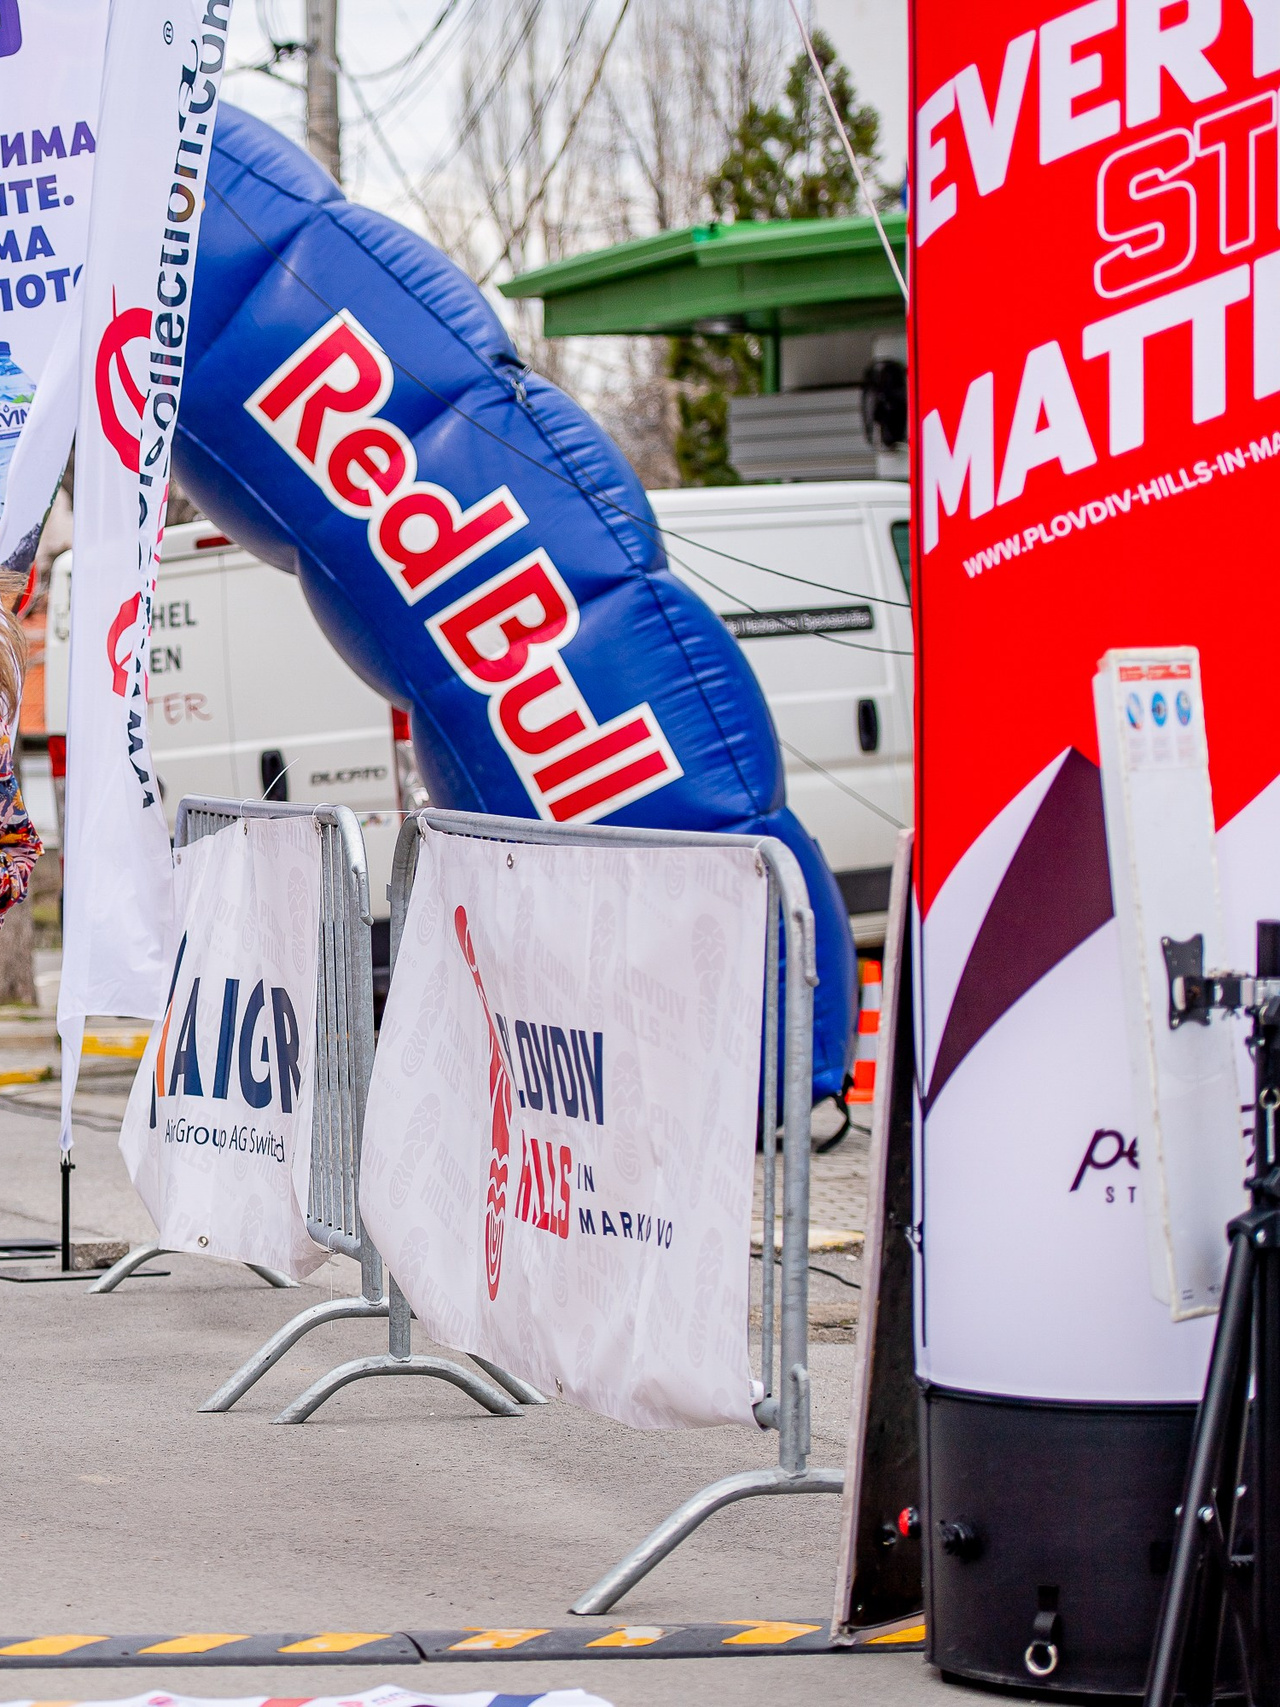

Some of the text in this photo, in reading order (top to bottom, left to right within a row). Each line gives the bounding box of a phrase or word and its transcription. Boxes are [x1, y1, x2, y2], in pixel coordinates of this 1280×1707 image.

[1093, 85, 1280, 299] ST
[922, 250, 1280, 555] MATT
[255, 320, 671, 823] Red Bull
[151, 601, 198, 629] HEL
[149, 647, 182, 674] EN
[148, 692, 214, 725] TER
[228, 1125, 248, 1151] AG
[577, 1162, 596, 1192] IN
